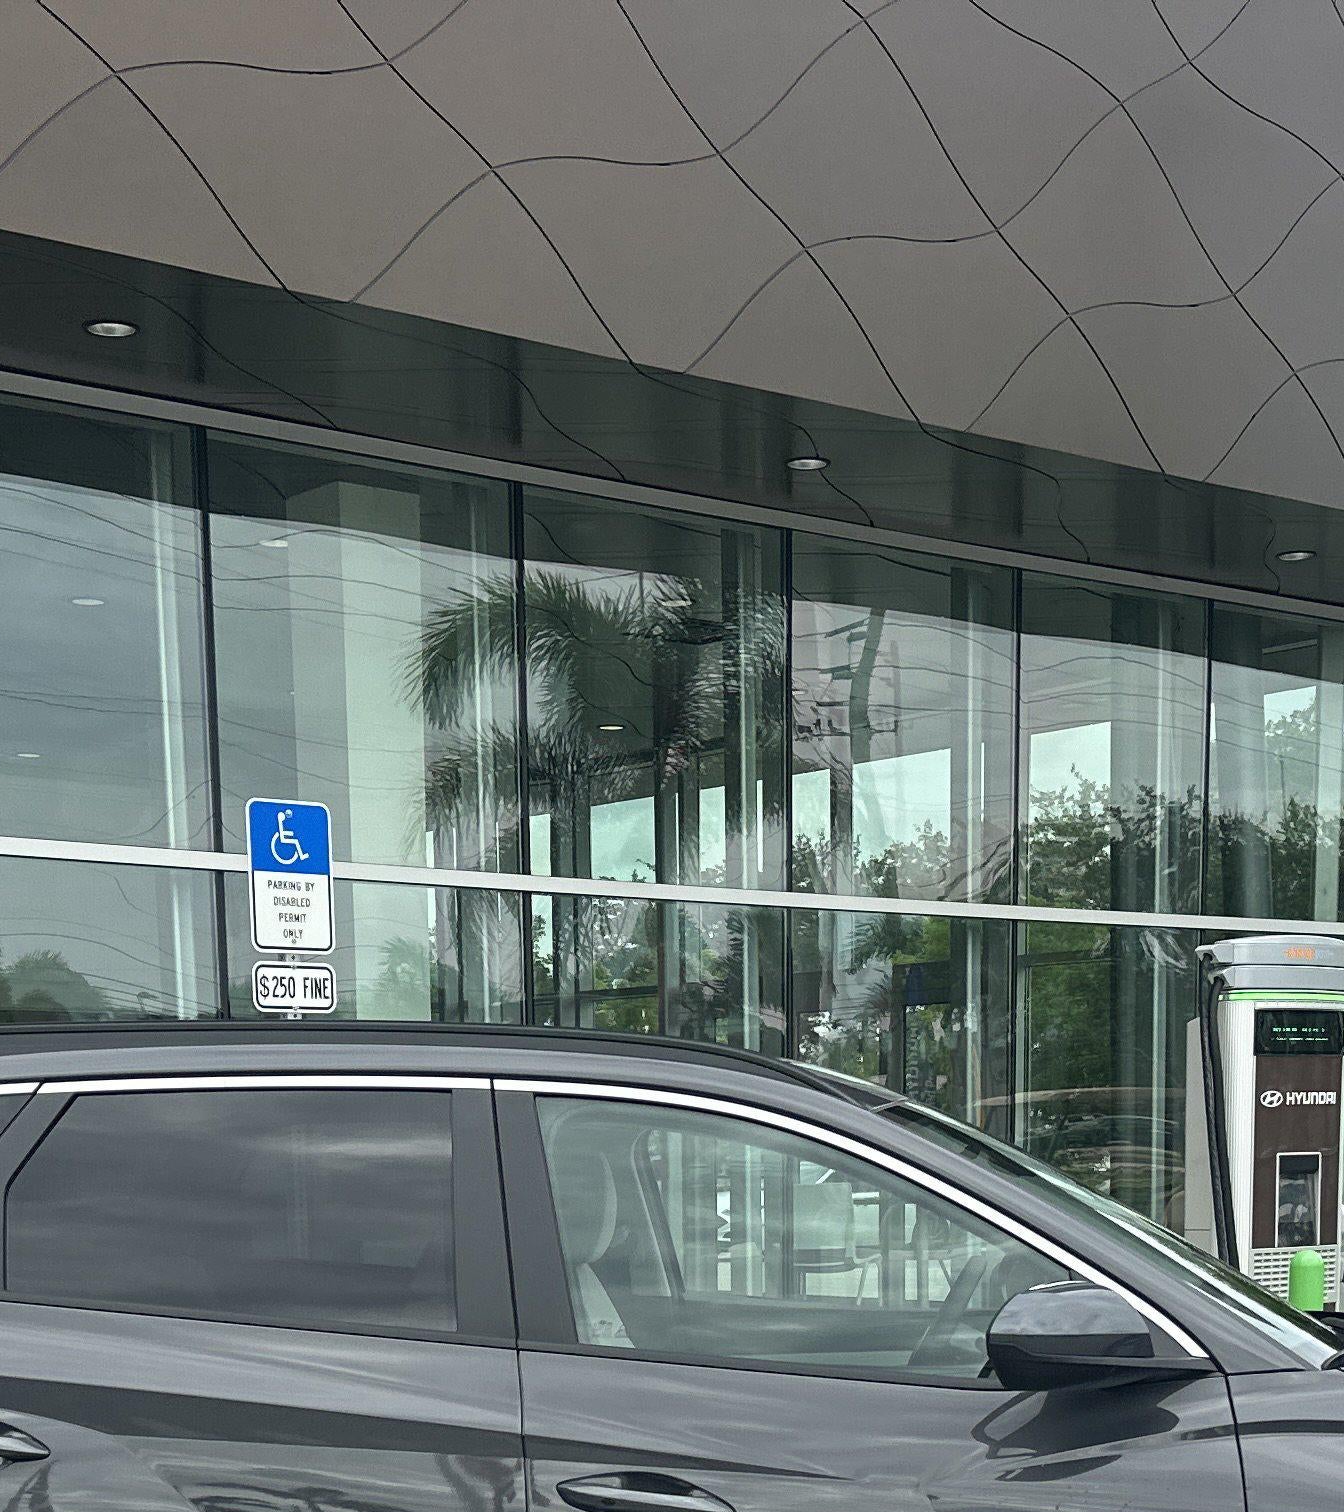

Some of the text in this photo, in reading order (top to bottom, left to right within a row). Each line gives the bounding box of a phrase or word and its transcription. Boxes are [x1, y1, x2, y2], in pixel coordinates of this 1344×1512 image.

[267, 879, 315, 891] PARKING BY
[273, 896, 311, 908] DISABLED
[278, 912, 307, 923] PERMIT
[283, 928, 304, 939] ONLY
[259, 974, 330, 1000] $250 FINE
[1285, 1091, 1337, 1106] HYUNDAI
